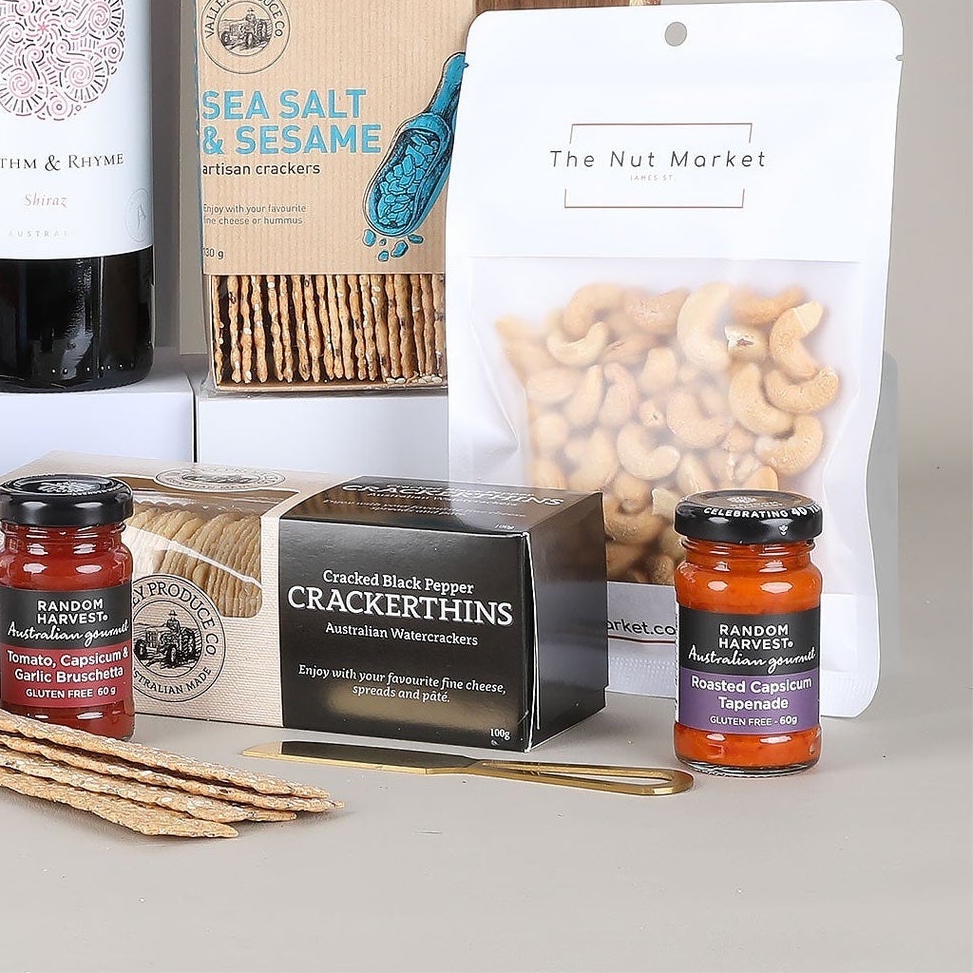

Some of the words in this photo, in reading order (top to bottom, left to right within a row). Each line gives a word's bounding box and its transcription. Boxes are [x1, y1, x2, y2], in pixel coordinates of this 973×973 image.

[202, 90, 270, 120] SEA
[279, 89, 367, 119] SALT
[202, 125, 225, 156] &
[235, 123, 382, 155] SESAME
[44, 154, 61, 172] &
[550, 150, 595, 168] The
[610, 150, 655, 168] Nut
[670, 149, 766, 168] Market
[202, 162, 251, 176] artisan
[255, 161, 321, 176] crackers
[24, 192, 68, 209] Shiraz
[226, 204, 244, 214] with
[246, 206, 265, 215] your
[268, 204, 307, 213] favourite
[218, 216, 250, 225] cheese
[252, 217, 262, 225] or
[263, 216, 303, 225] hummus
[217, 250, 224, 260] g
[341, 484, 565, 506] CRACKERTHINS
[704, 507, 788, 519] CELEBRATING
[791, 506, 807, 517] 40
[323, 569, 380, 587] Cracked
[383, 574, 422, 590] Black
[424, 577, 475, 597] Pepper
[37, 598, 103, 612] RANDOM
[147, 581, 215, 630] PRODUCE
[287, 584, 514, 627] CRACKERTHINS
[7, 621, 83, 640] Australian
[84, 618, 129, 648] gourmet
[325, 621, 388, 639] Australian
[391, 627, 478, 646] Watercrackers
[719, 623, 789, 636] RANDOM
[7, 649, 57, 669] Tomato,
[60, 651, 122, 668] Capsicum
[122, 646, 129, 658] &
[688, 644, 766, 666] Australian
[767, 646, 816, 674] gourmet
[14, 668, 52, 683] Garlic
[56, 666, 124, 683] Bruschetta
[187, 666, 212, 692] MADE
[298, 664, 330, 679] Enjoy
[332, 668, 357, 681] with
[358, 672, 386, 684] your
[386, 672, 440, 689] favourite
[441, 676, 464, 691] fine
[465, 679, 507, 696] cheese,
[26, 688, 65, 699] GLUTEN
[67, 688, 93, 698] FREE
[352, 684, 396, 699] spreads
[398, 688, 420, 701] and
[422, 689, 451, 704] pâté.
[691, 675, 746, 694] Roasted
[750, 677, 812, 695] Capsicum
[718, 696, 789, 712] Tapenade
[709, 715, 746, 726] GLUTEN
[748, 717, 772, 726] FREE
[779, 715, 798, 726] 60g
[490, 728, 511, 741] 100g
